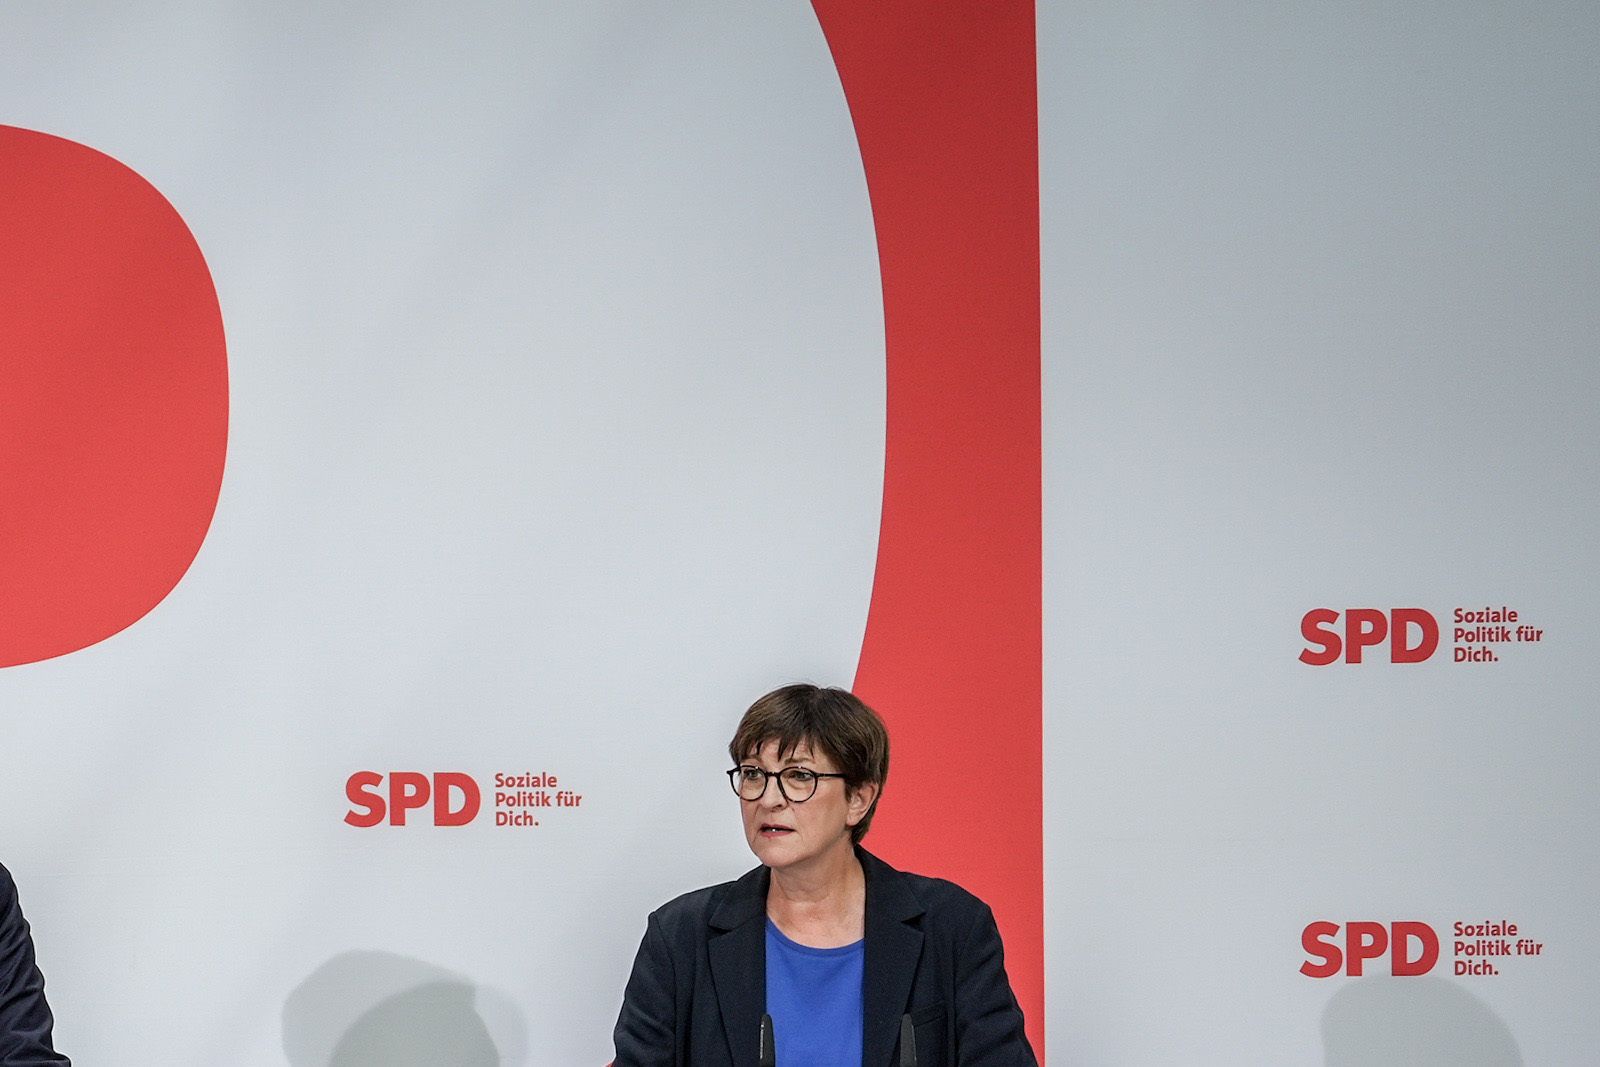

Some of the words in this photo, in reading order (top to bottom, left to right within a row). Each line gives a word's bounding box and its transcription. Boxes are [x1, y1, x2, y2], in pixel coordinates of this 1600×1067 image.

[1454, 606, 1519, 623] Soziale
[1299, 607, 1440, 666] SPD
[1454, 625, 1512, 642] Politik
[1516, 625, 1544, 642] für
[1454, 645, 1500, 663] Dich.
[494, 771, 558, 788] Soziale
[343, 770, 482, 828] SPD
[495, 790, 553, 807] Politik
[556, 790, 582, 807] für
[495, 810, 539, 827] Dich.
[1453, 920, 1519, 937] Soziale
[1300, 920, 1440, 979] SPD
[1454, 939, 1513, 957] Politik
[1515, 939, 1543, 956] für
[1454, 959, 1500, 976] Dich.
